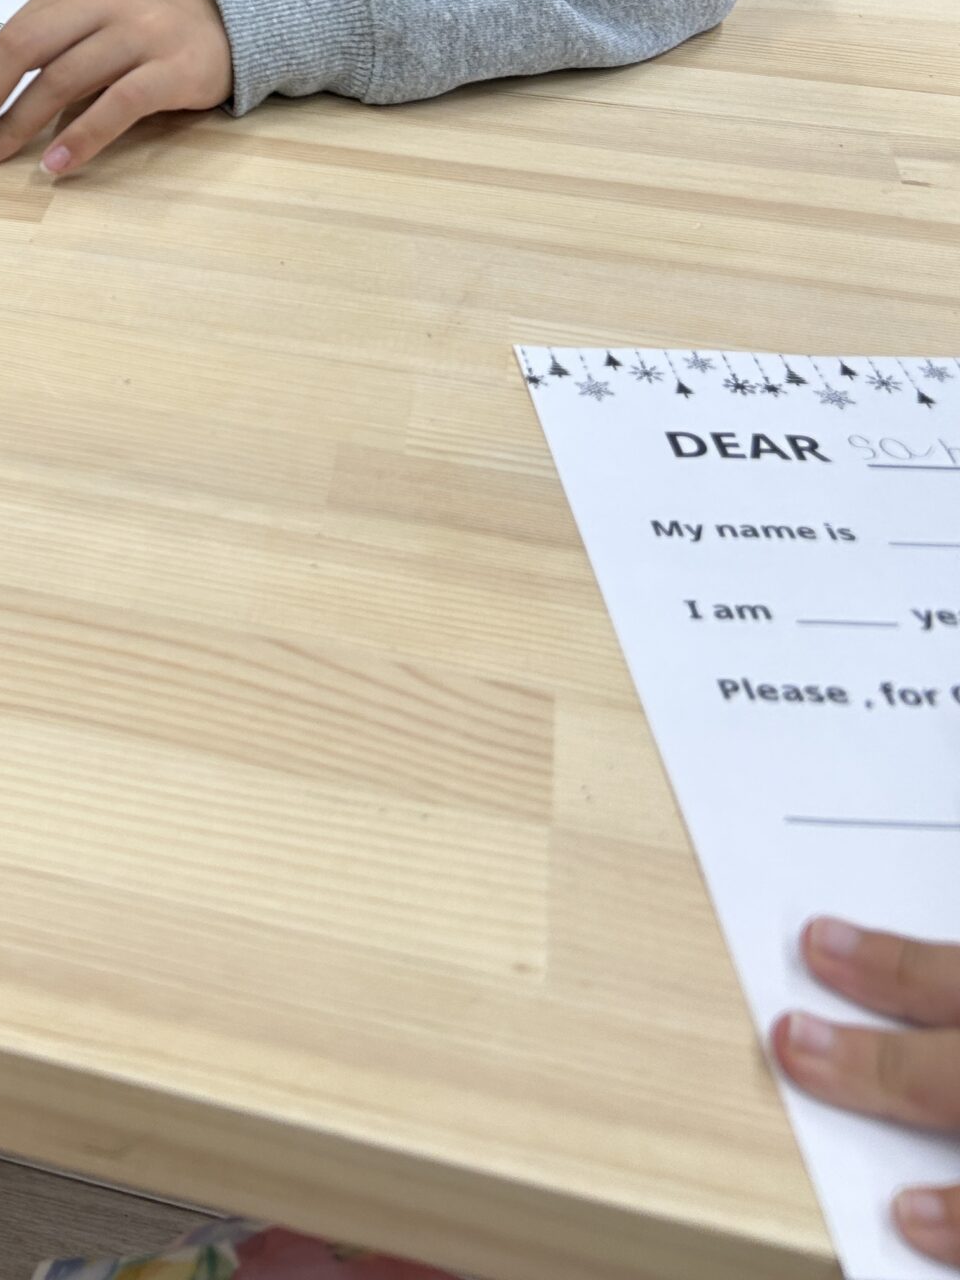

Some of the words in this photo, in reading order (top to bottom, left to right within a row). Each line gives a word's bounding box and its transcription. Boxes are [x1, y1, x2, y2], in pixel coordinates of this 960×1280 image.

[664, 431, 833, 463] DEAR
[650, 520, 703, 542] My
[715, 523, 817, 540] name
[823, 522, 857, 542] is
[683, 599, 703, 620] I
[712, 603, 774, 621] am
[911, 608, 960, 631] ye
